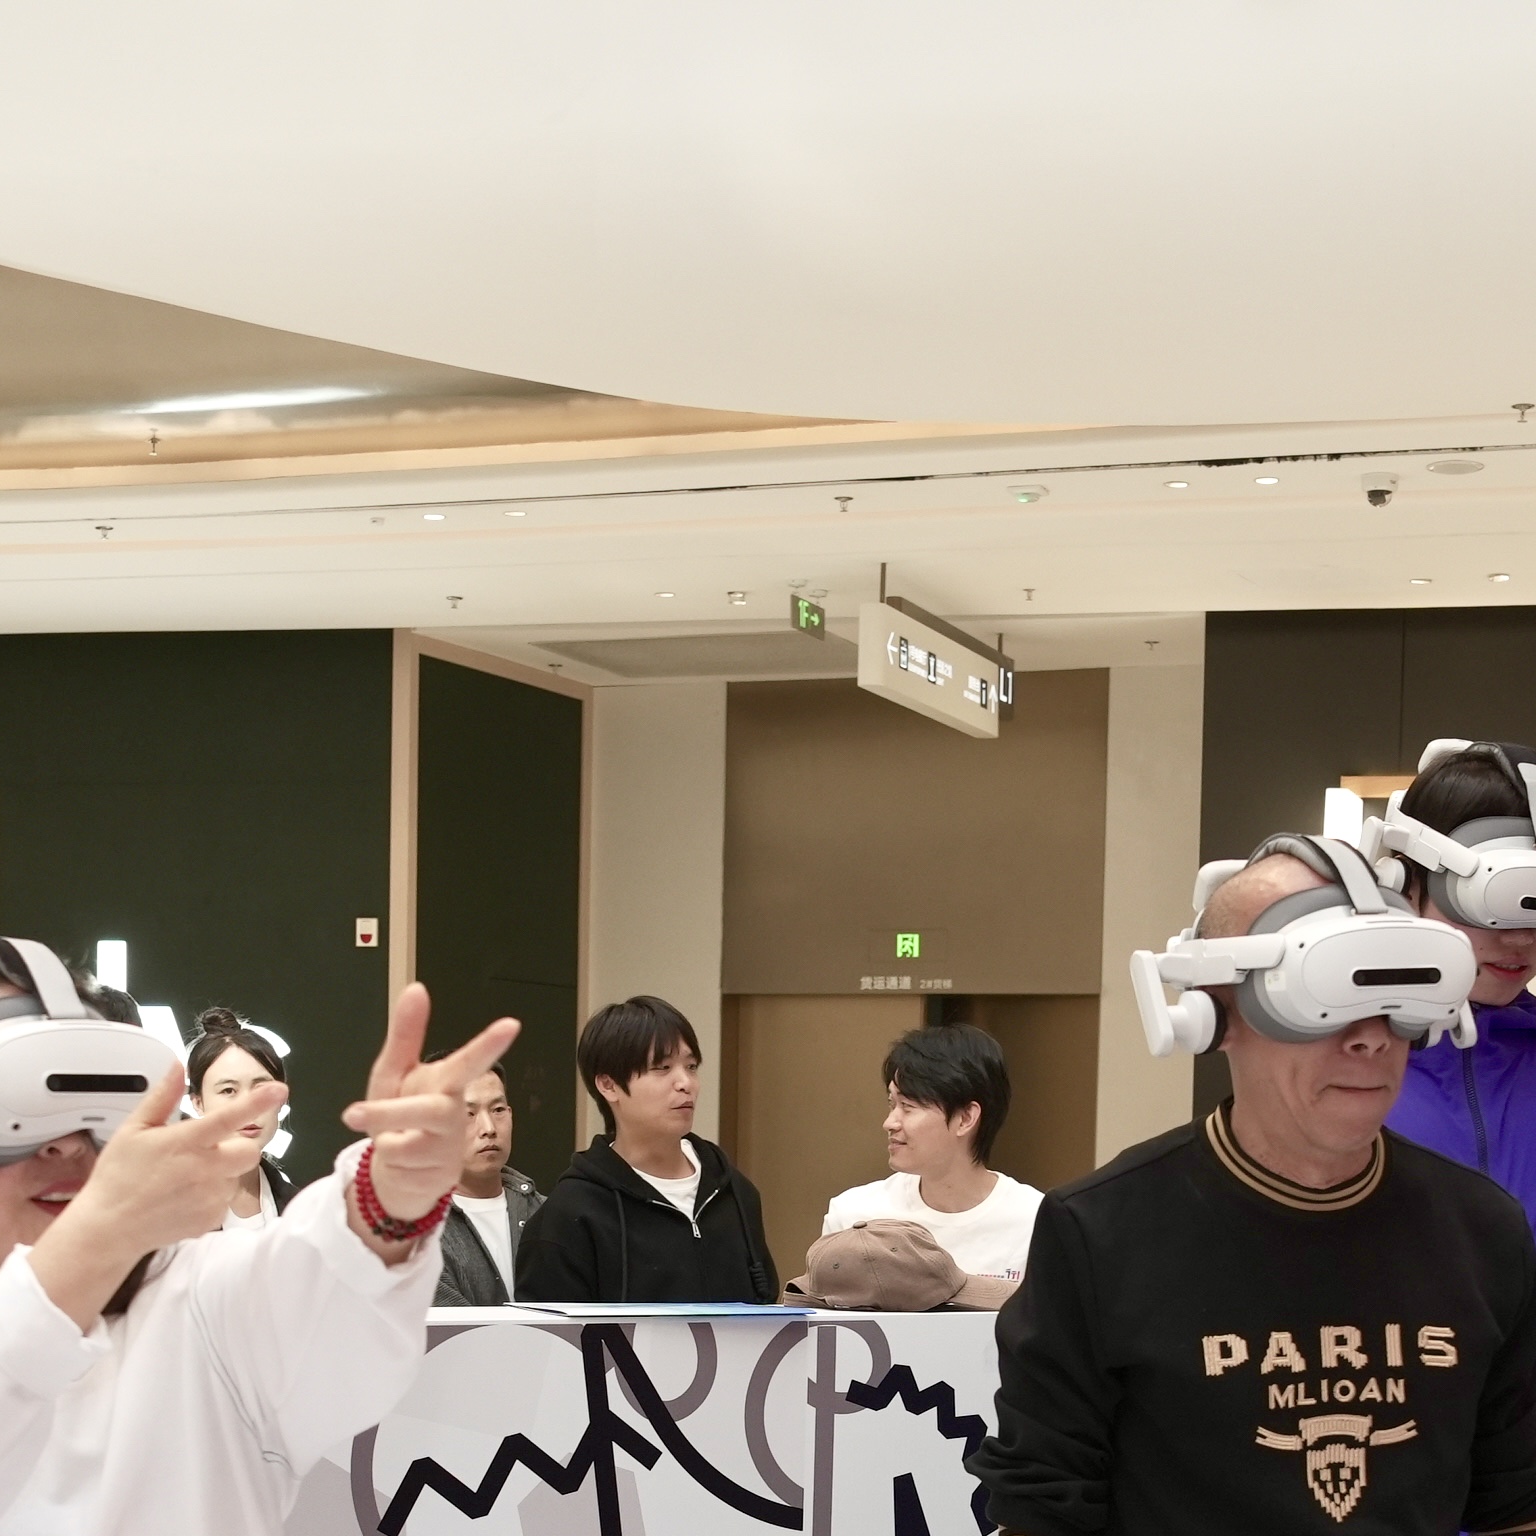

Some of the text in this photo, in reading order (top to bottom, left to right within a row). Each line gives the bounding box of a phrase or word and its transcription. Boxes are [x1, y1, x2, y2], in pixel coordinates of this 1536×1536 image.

[797, 599, 810, 629] 1F
[998, 667, 1013, 705] L1
[1201, 1322, 1459, 1377] PARIS
[1267, 1376, 1407, 1411] MLIOAN
